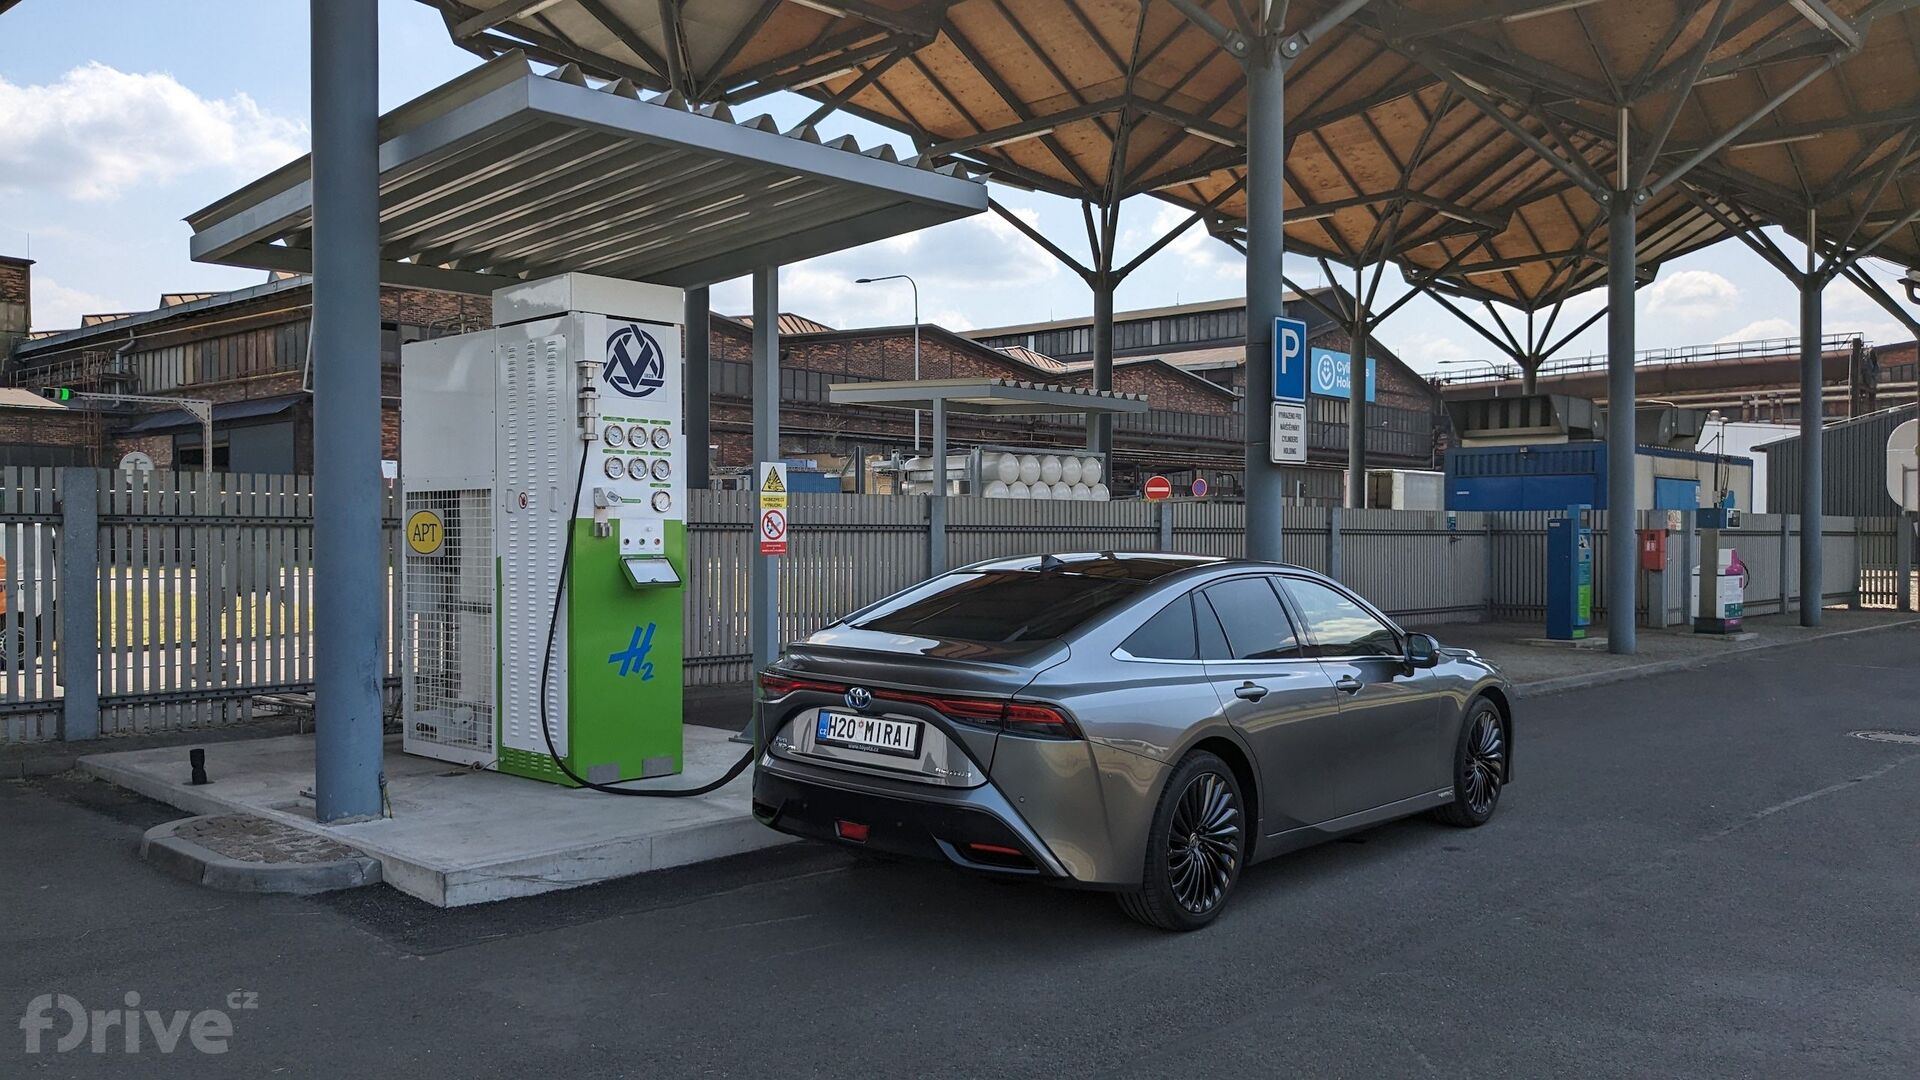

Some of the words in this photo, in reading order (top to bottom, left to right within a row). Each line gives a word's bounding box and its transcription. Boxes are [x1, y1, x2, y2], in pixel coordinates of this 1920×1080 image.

[1281, 327, 1300, 375] P
[412, 523, 438, 542] APT
[864, 719, 911, 748] MIRAI
